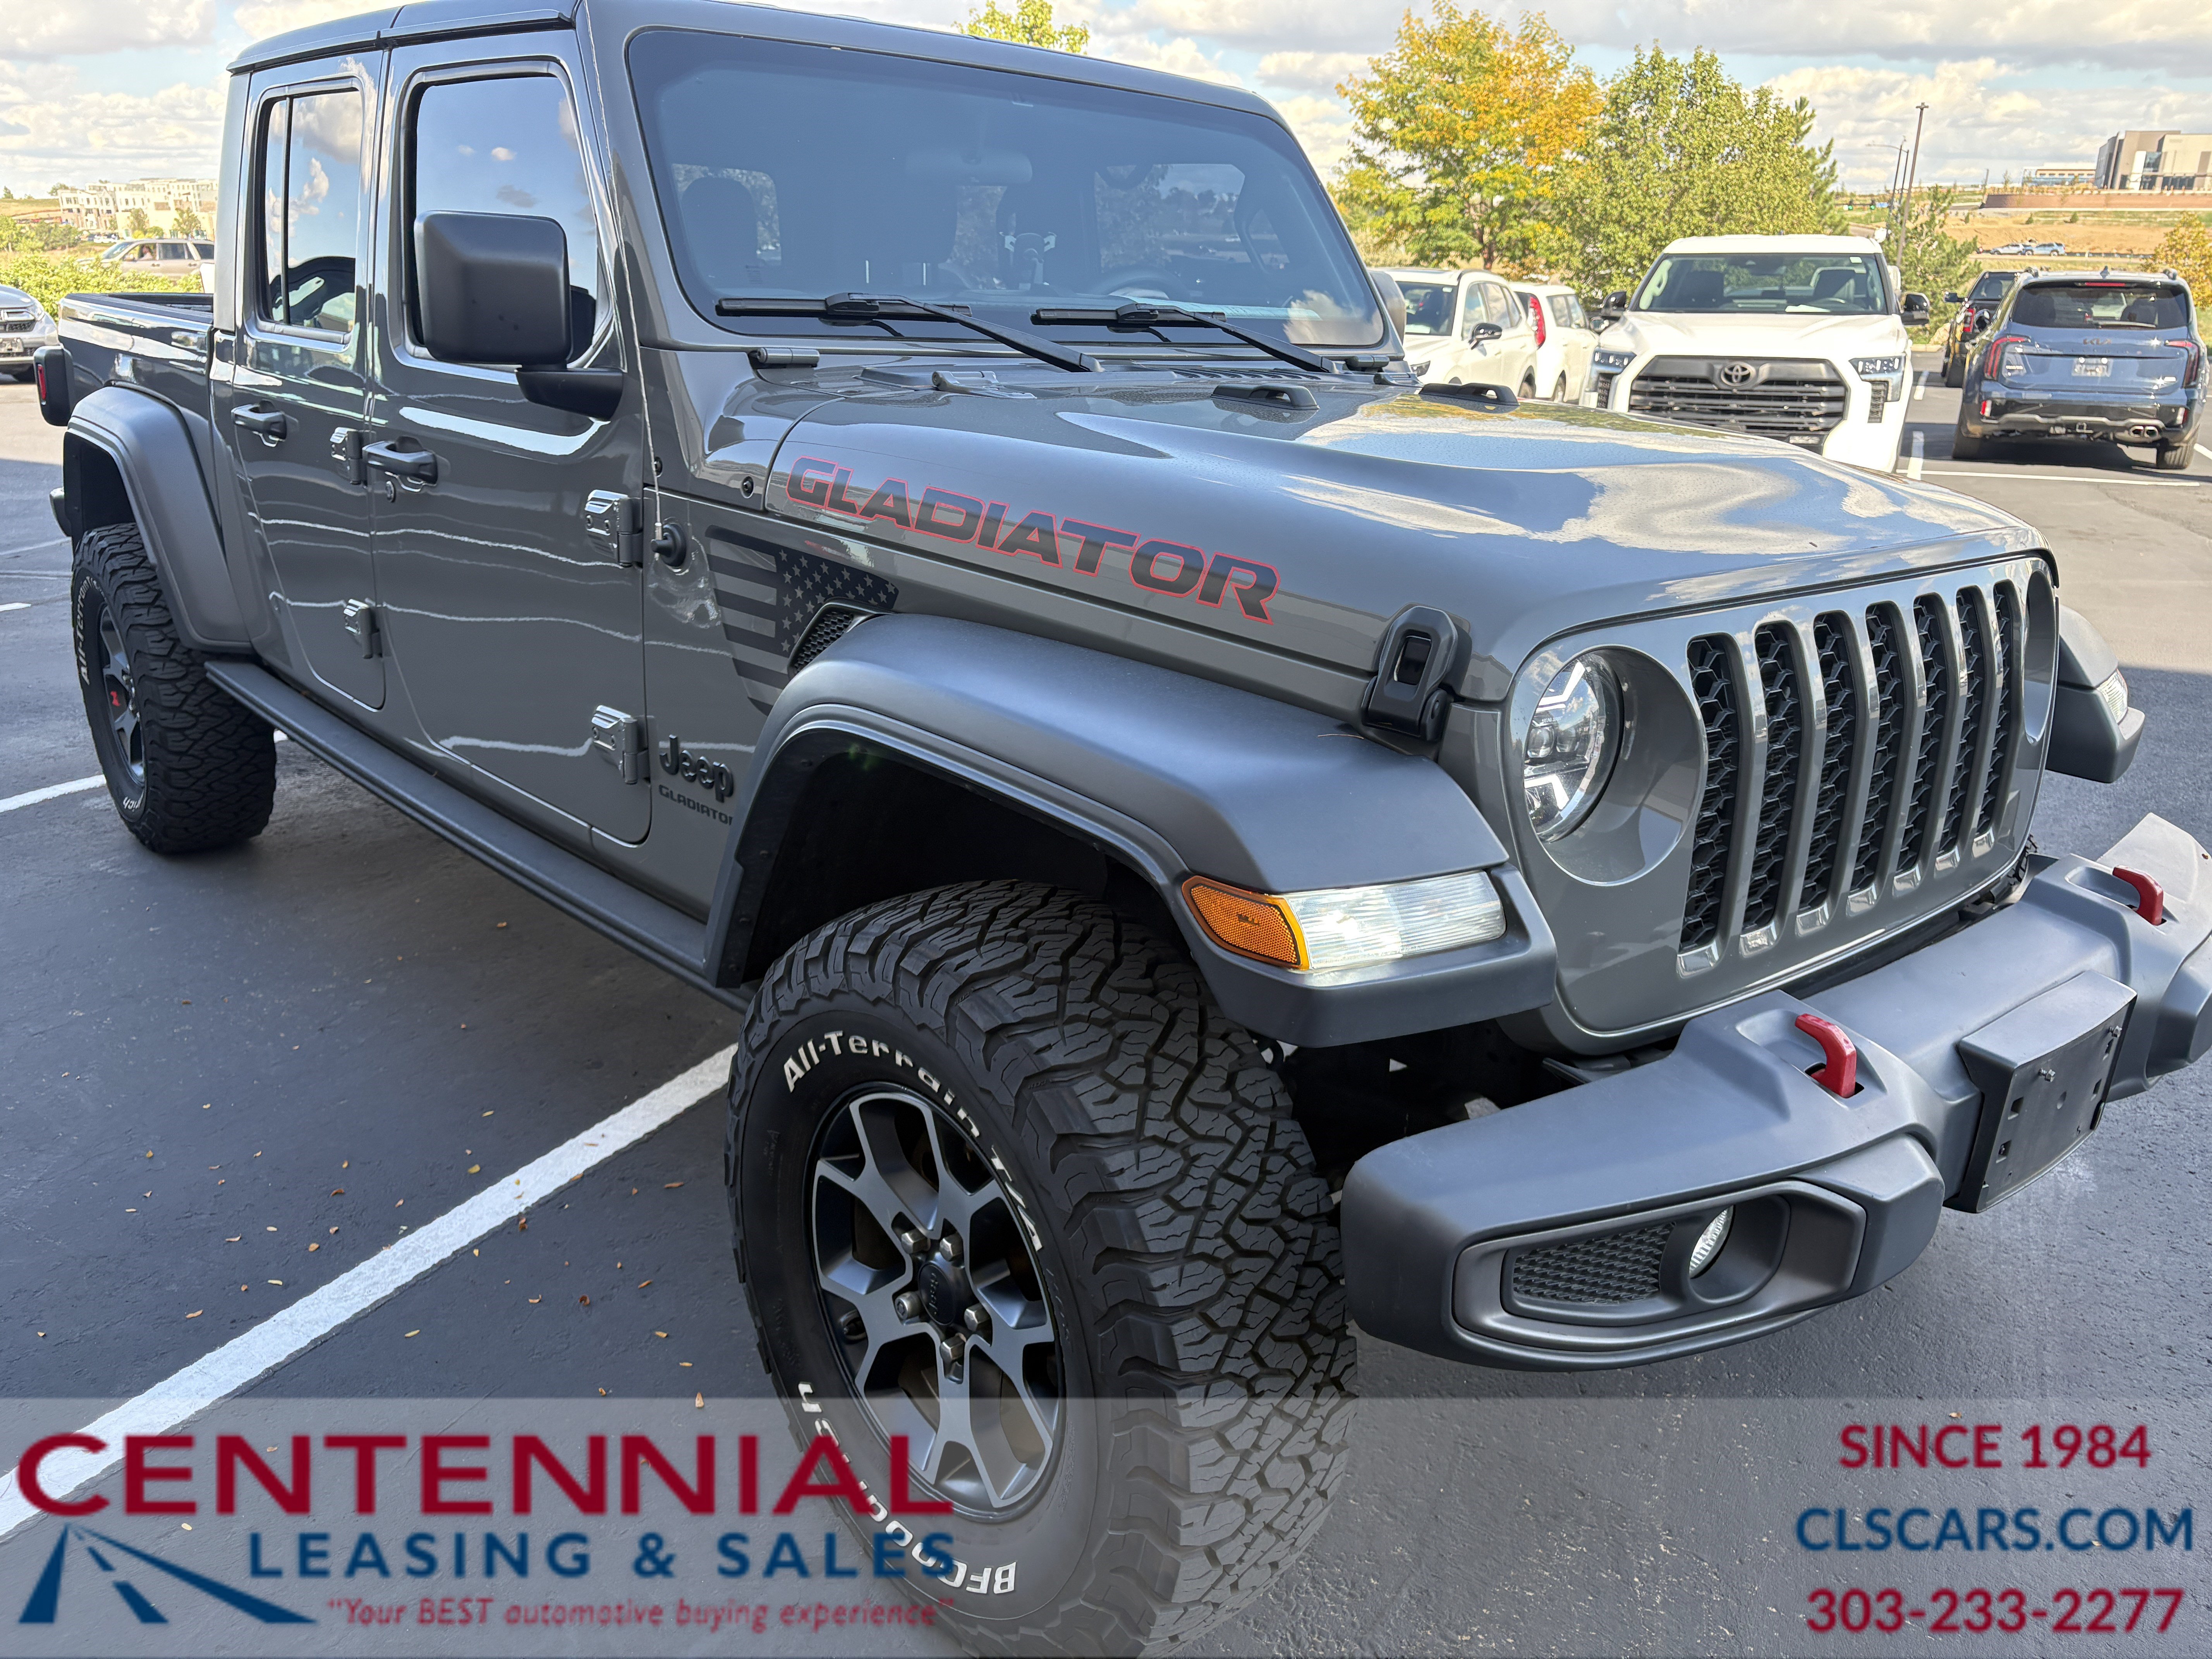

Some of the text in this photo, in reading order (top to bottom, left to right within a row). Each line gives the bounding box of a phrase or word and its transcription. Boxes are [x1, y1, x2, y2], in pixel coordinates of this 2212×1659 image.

[785, 455, 1281, 626] GLADIATOR
[76, 579, 90, 685] All-Terrain
[659, 734, 734, 803] Jeep
[783, 1030, 982, 1139] All-Terrain
